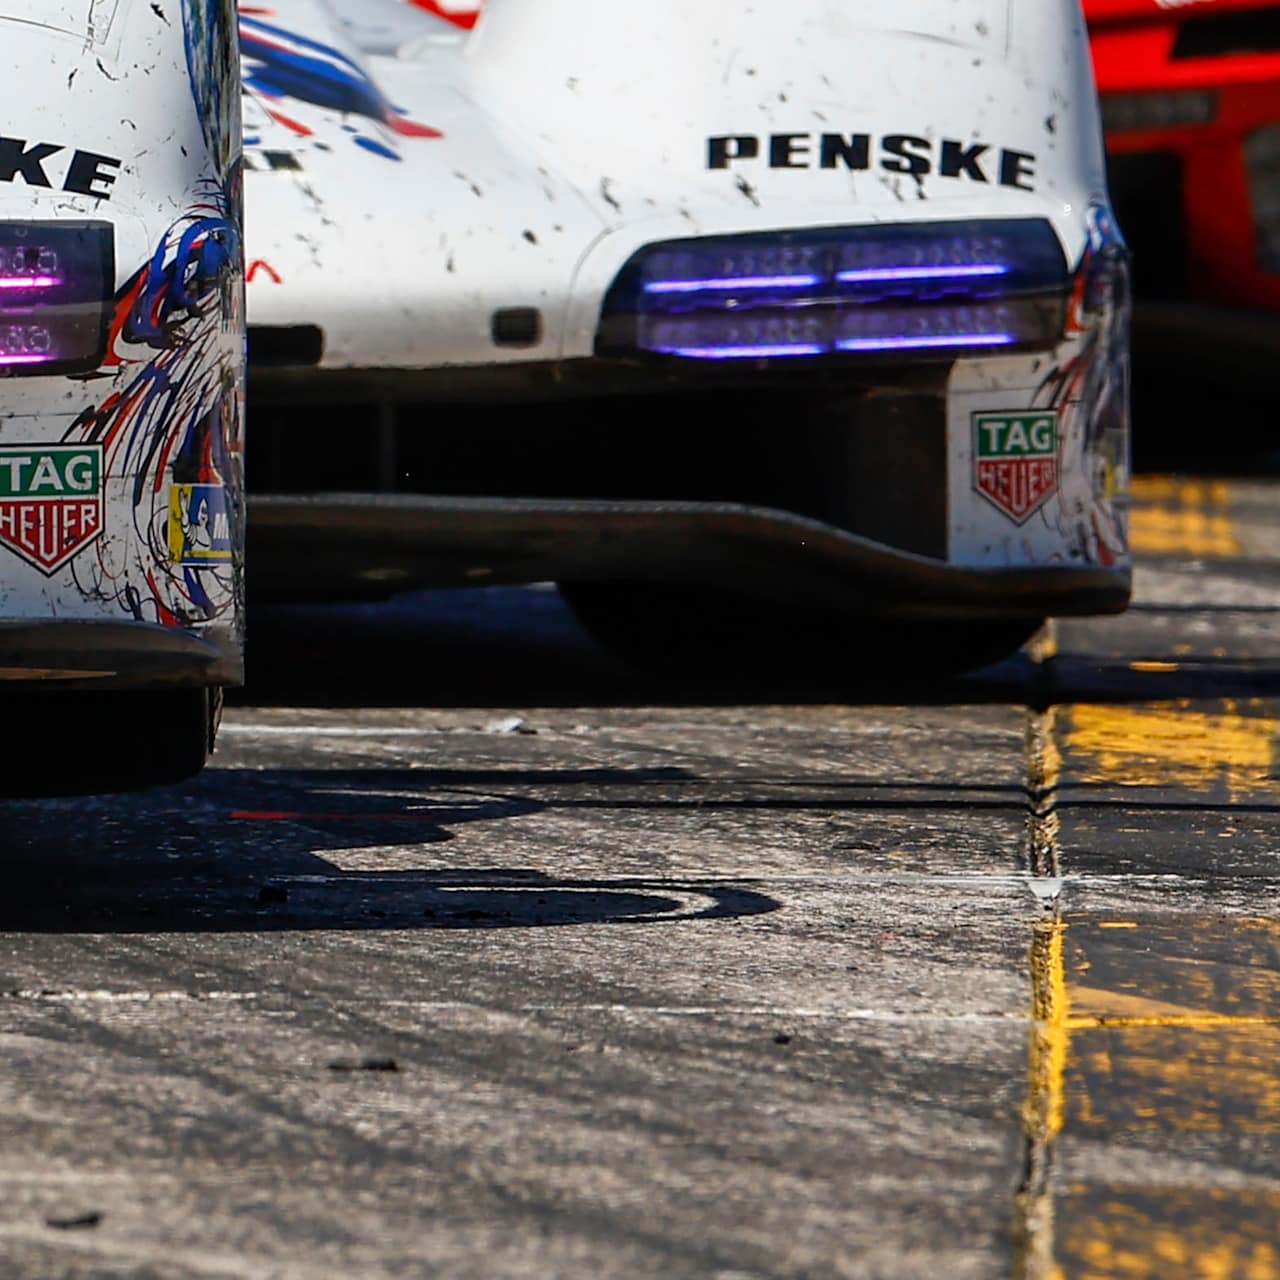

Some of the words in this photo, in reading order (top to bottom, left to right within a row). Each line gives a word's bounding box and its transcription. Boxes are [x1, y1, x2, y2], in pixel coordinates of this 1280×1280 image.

[706, 132, 1038, 192] PENSKE
[980, 418, 1053, 452] TAG
[978, 460, 1057, 516] HEUER
